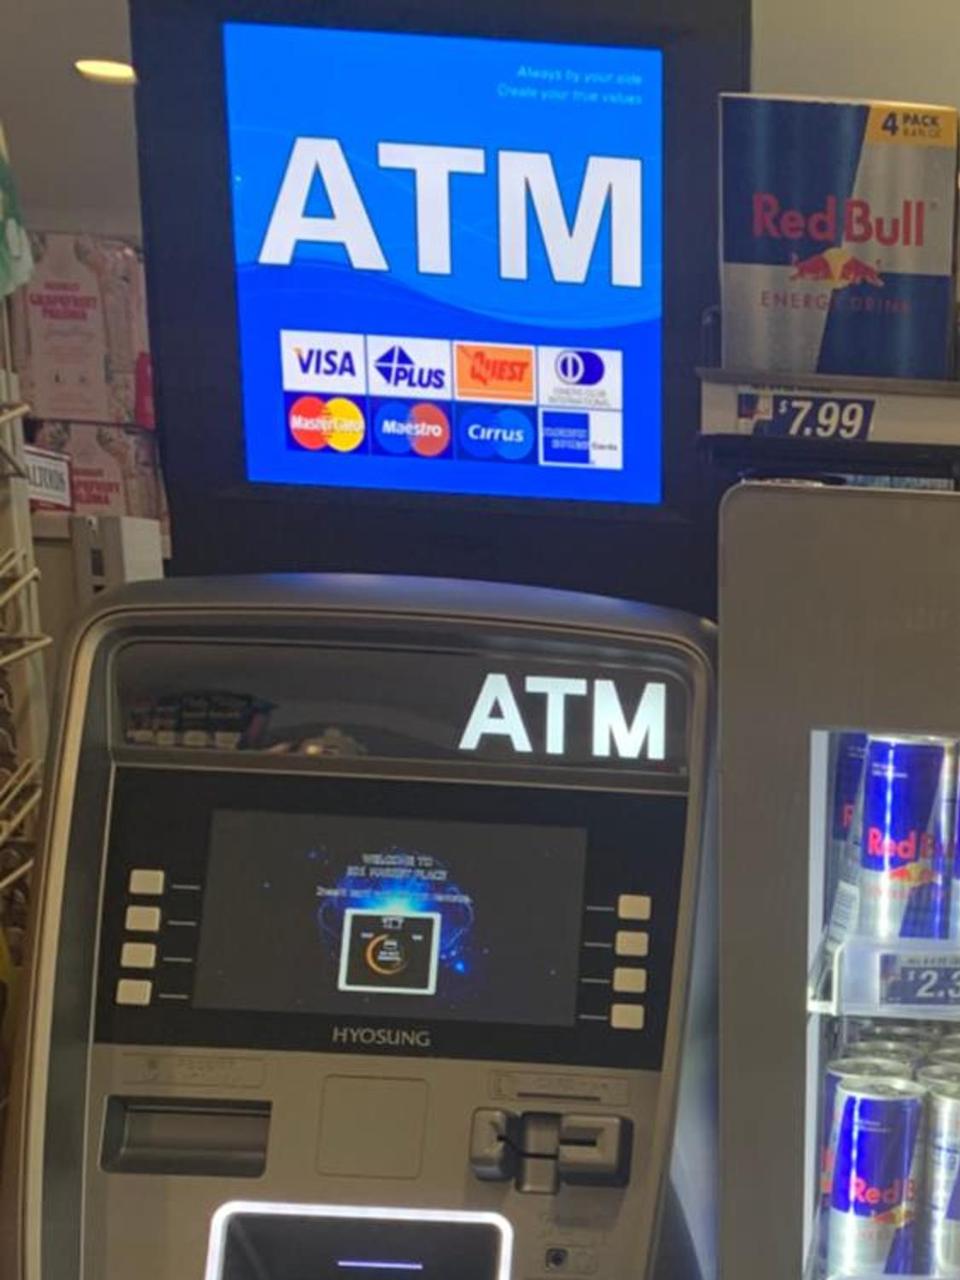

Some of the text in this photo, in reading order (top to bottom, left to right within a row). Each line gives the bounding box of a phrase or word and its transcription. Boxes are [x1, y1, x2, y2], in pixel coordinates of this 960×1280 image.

[881, 111, 898, 136] 4
[903, 113, 940, 127] PACK
[258, 136, 642, 288] ATM
[752, 192, 925, 248] Red Bull
[293, 347, 356, 377] VISA
[393, 366, 446, 390] PLUS
[381, 419, 443, 438] Maestro
[778, 399, 865, 438] $7.99
[467, 423, 525, 443] Cirrus
[457, 672, 666, 761] ATM
[867, 827, 916, 860] Red
[332, 1026, 432, 1047] HYOSUNG
